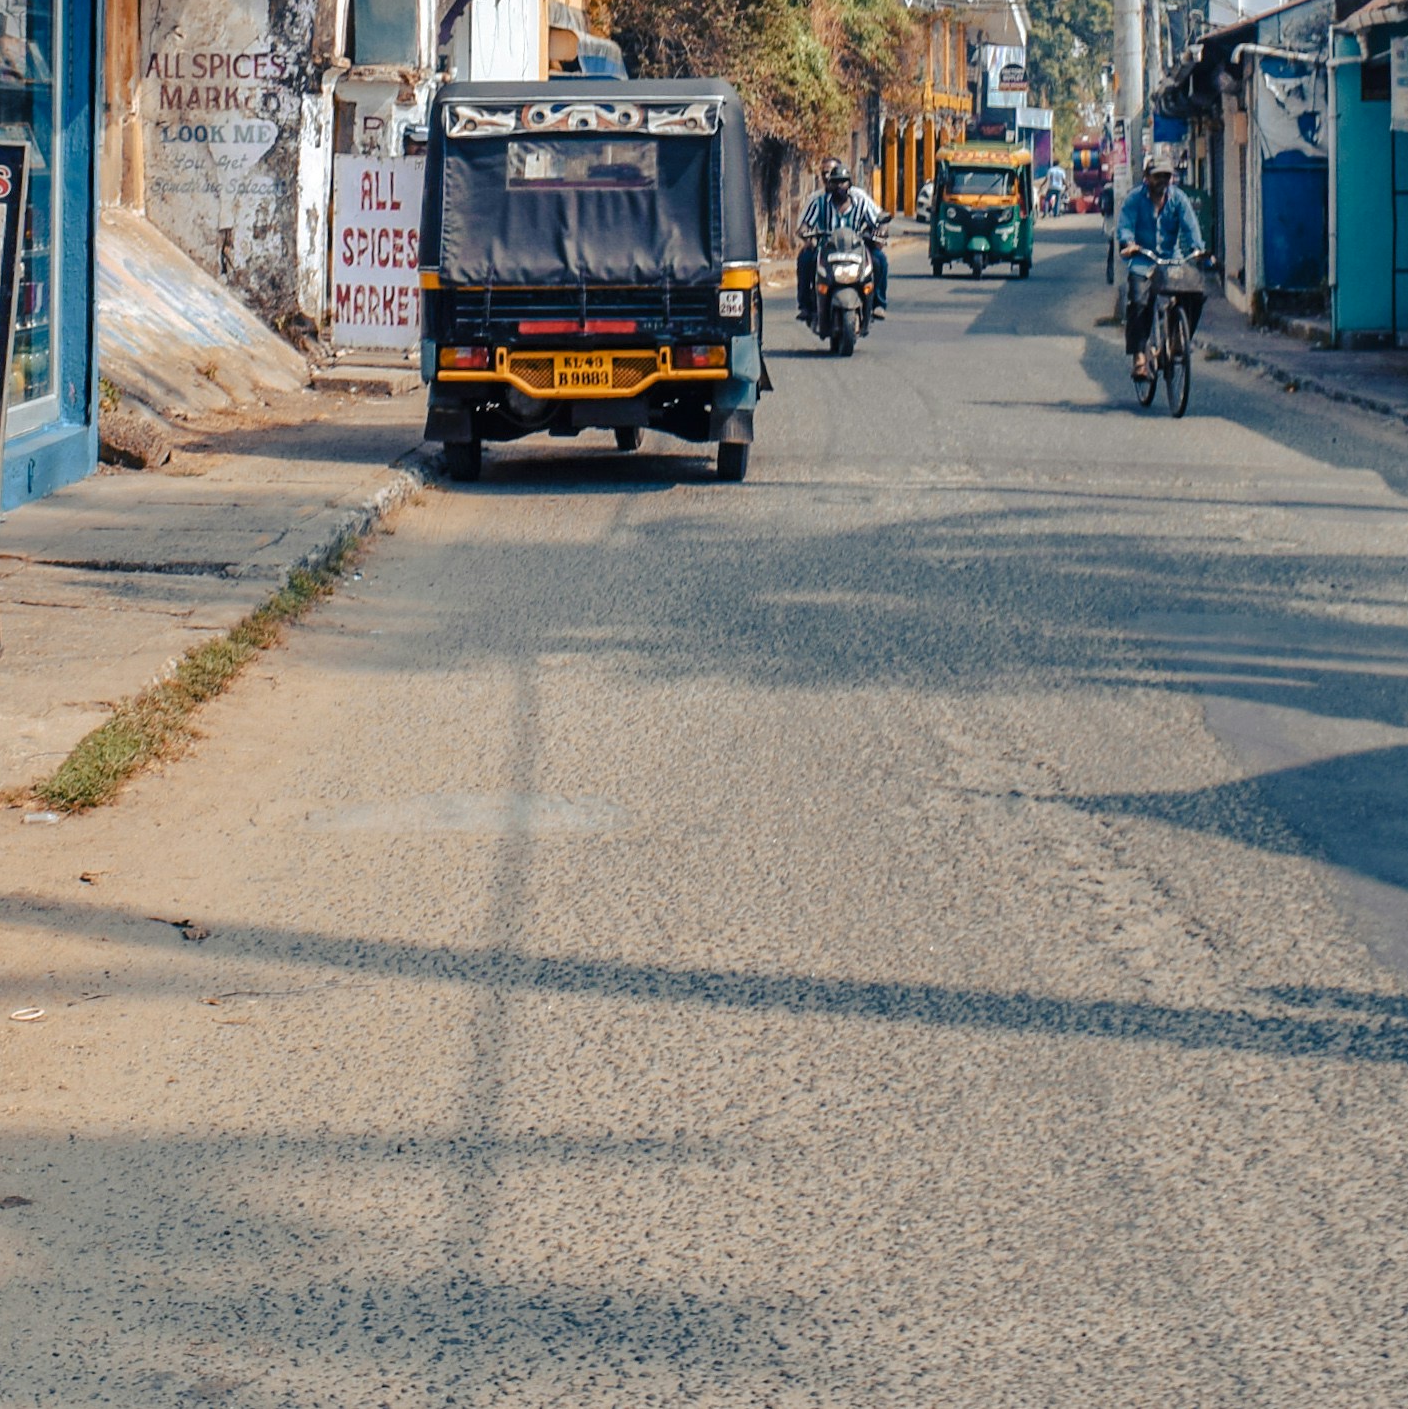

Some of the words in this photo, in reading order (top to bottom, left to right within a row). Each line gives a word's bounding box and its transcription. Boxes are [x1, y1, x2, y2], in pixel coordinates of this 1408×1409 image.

[146, 53, 185, 79] ALL
[191, 53, 288, 80] SPICES
[161, 125, 225, 143] LOOK
[233, 124, 273, 143] ME
[361, 170, 402, 211] ALL
[342, 227, 420, 269] SPICES
